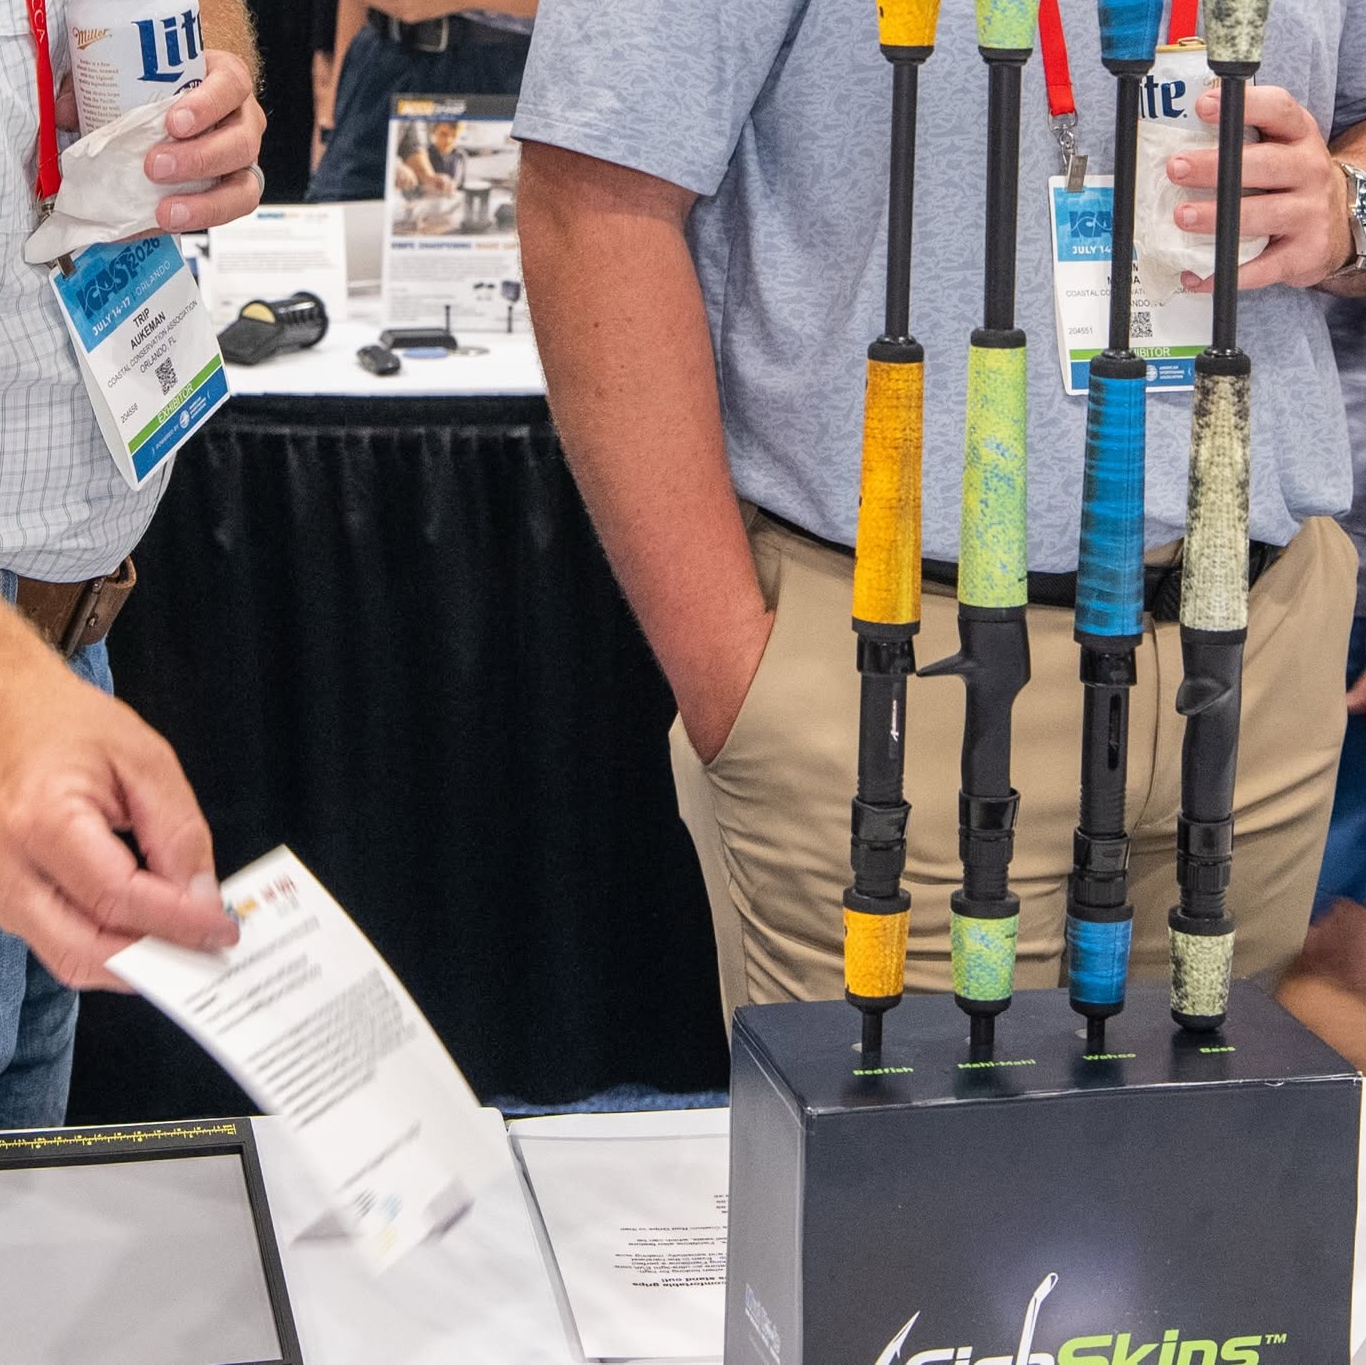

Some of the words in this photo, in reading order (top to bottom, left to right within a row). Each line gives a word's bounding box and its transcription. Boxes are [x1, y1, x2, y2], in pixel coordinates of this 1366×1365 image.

[72, 26, 110, 48] Miller
[131, 8, 204, 83] Lit
[1138, 73, 1186, 120] ite
[1072, 245, 1097, 255] JULY
[1098, 245, 1112, 255] 14
[92, 314, 113, 336] JULY
[110, 297, 132, 320] 14-17
[134, 260, 172, 297] ORLANDO
[1066, 289, 1099, 298] COASTAL
[132, 307, 151, 329] TRIP
[130, 311, 167, 350] AUKEMAN
[107, 365, 133, 388] COASTAL
[130, 330, 167, 368] CONSERVATION
[164, 299, 199, 336] ASSOCIATION
[157, 382, 195, 425] EXHIBITOR
[1083, 1052, 1137, 1061] Wahoo
[1199, 1046, 1236, 1054] Bass
[852, 1066, 915, 1076] Redfish
[956, 1058, 1037, 1069] Mahi-Mahi
